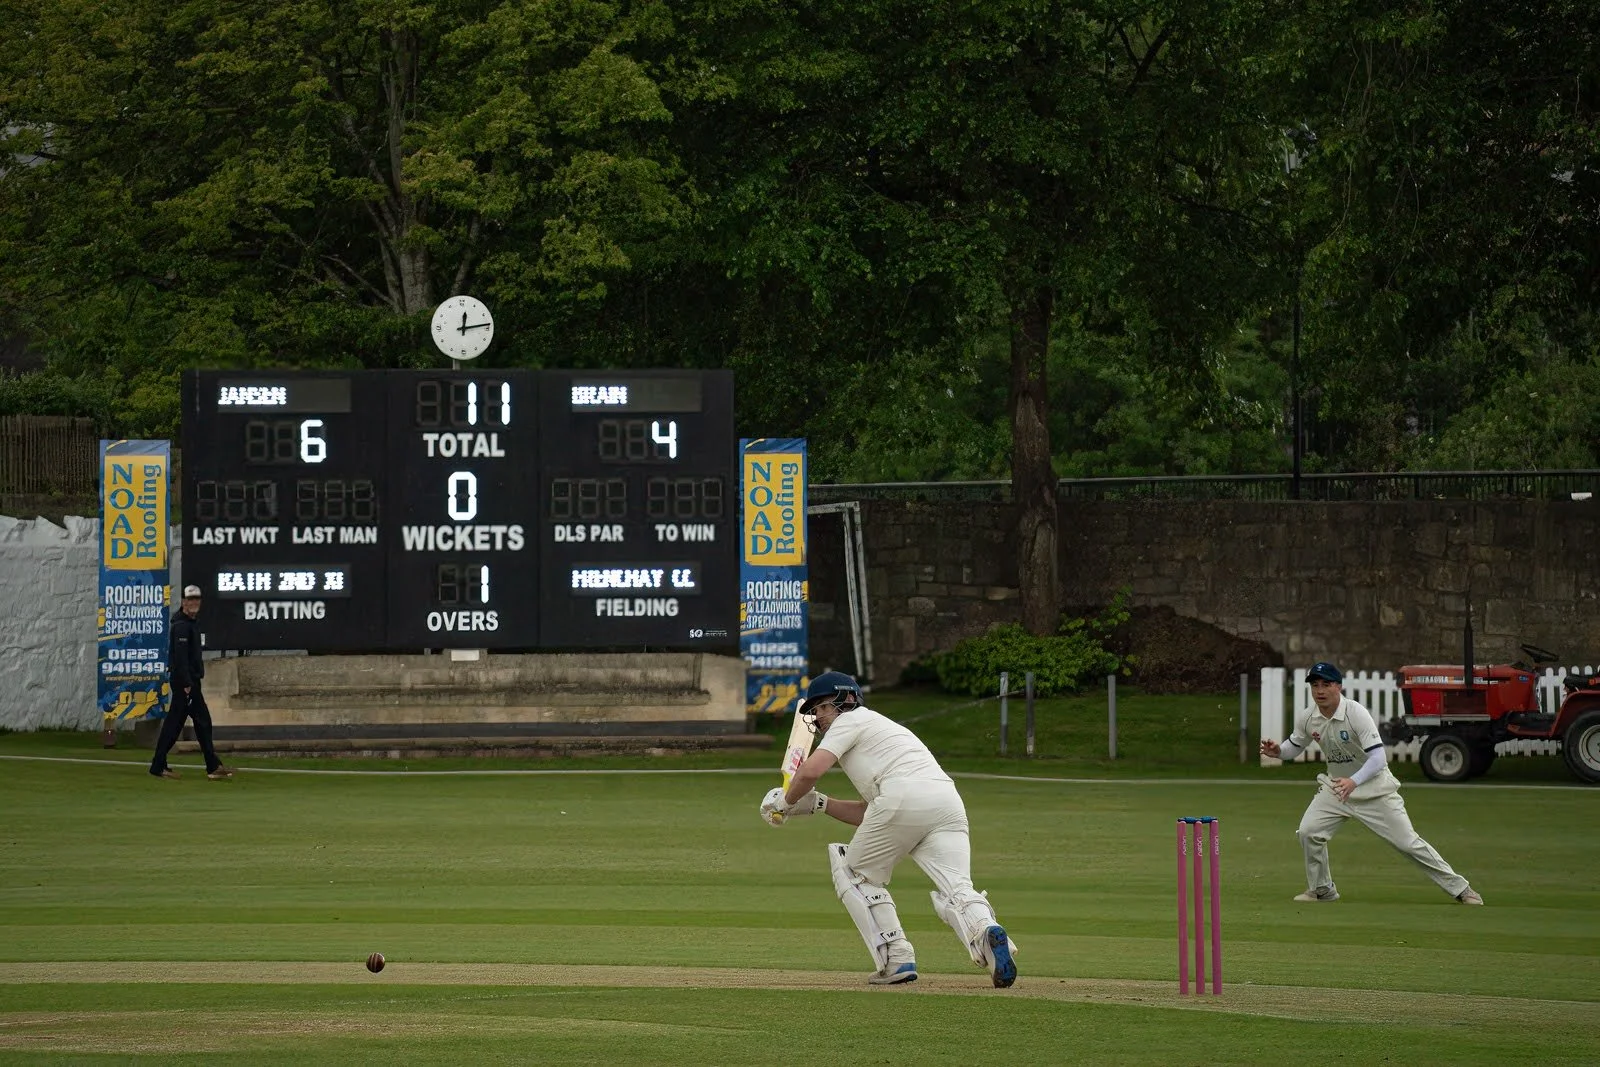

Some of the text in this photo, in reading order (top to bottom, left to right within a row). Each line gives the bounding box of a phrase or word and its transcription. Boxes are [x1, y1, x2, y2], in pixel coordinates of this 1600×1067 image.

[467, 382, 511, 425] 11
[300, 419, 326, 463] 6
[422, 432, 506, 458] TOTAL
[652, 420, 677, 459] 4
[448, 471, 477, 520] 0
[109, 463, 135, 559] NOAD
[136, 464, 162, 558] Roofing
[749, 461, 773, 555] NOAD
[775, 462, 799, 554] Roofing
[192, 526, 279, 545] LAST WKT
[292, 526, 377, 545] LAST MAN
[402, 524, 525, 551] WICKETS
[554, 524, 624, 542] DLS PAR
[655, 523, 716, 542] TO WIN
[481, 564, 490, 604] 1
[746, 580, 801, 600] ROOFING
[105, 585, 163, 605] ROOFING
[115, 605, 163, 619] LEADWORK
[244, 601, 326, 620] BATTING
[595, 598, 679, 617] FIELDING
[105, 620, 163, 634] SPECIALISTS
[426, 610, 499, 631] OVERS
[108, 648, 160, 660] 01225
